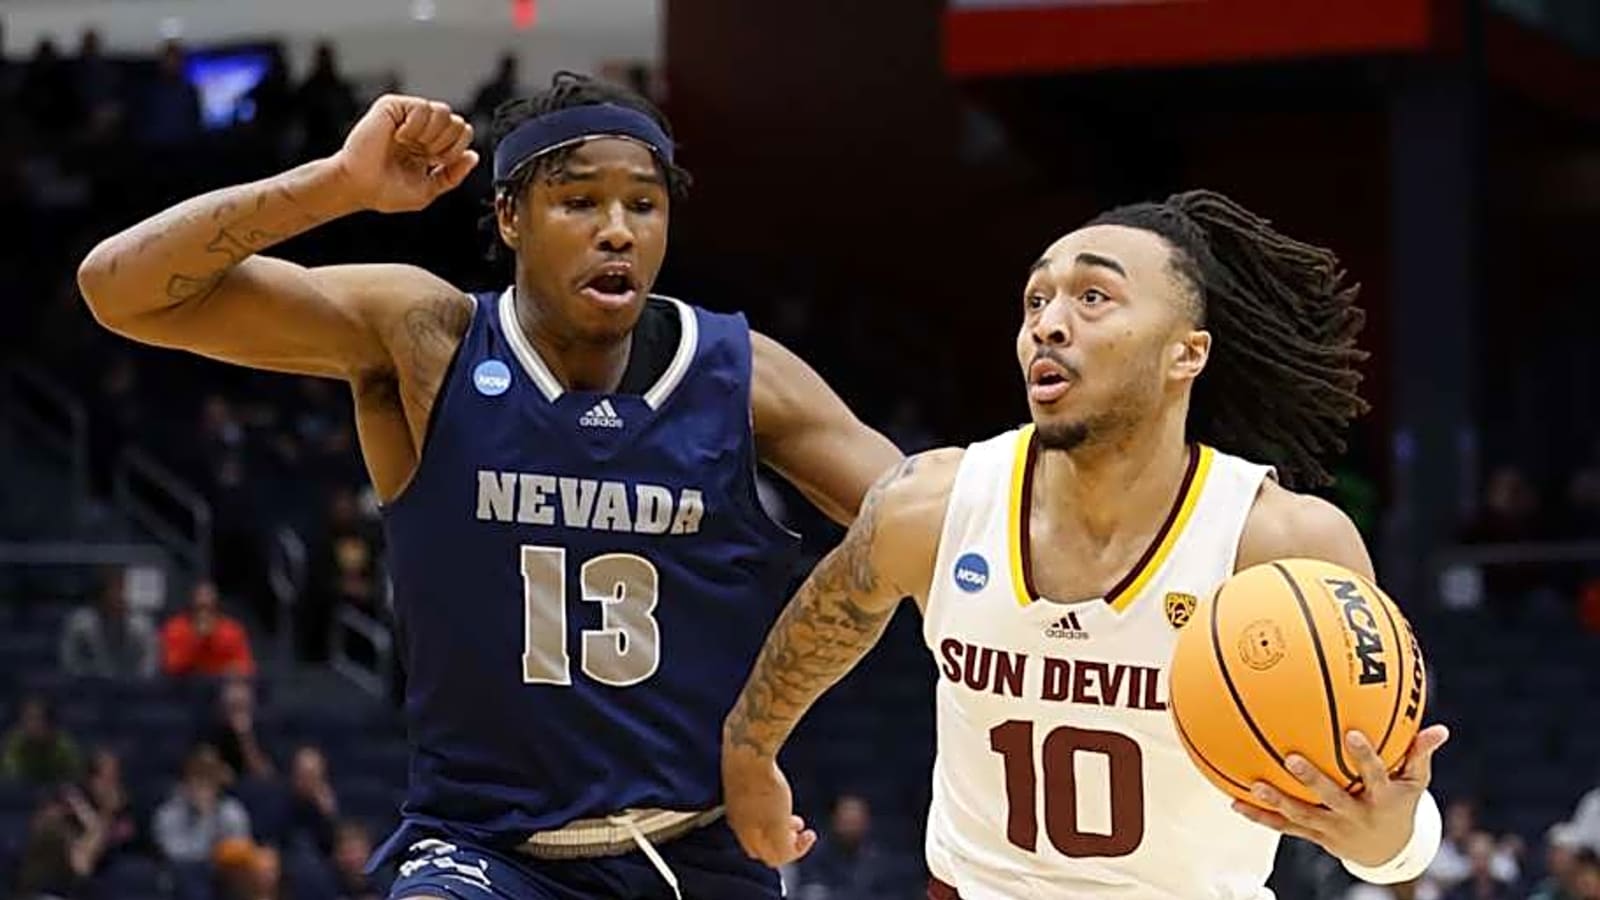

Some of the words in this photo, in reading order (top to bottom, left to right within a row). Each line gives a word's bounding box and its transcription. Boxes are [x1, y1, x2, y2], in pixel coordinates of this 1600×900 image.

[579, 416, 623, 428] adidas
[476, 470, 704, 535] NEVADA
[957, 568, 986, 586] NCAA
[520, 545, 660, 686] 13
[1044, 629, 1089, 640] adidas
[1324, 579, 1387, 686] NCAA
[940, 638, 1027, 698] SUN
[1041, 657, 1169, 711] DEVIL
[989, 719, 1144, 858] 10
